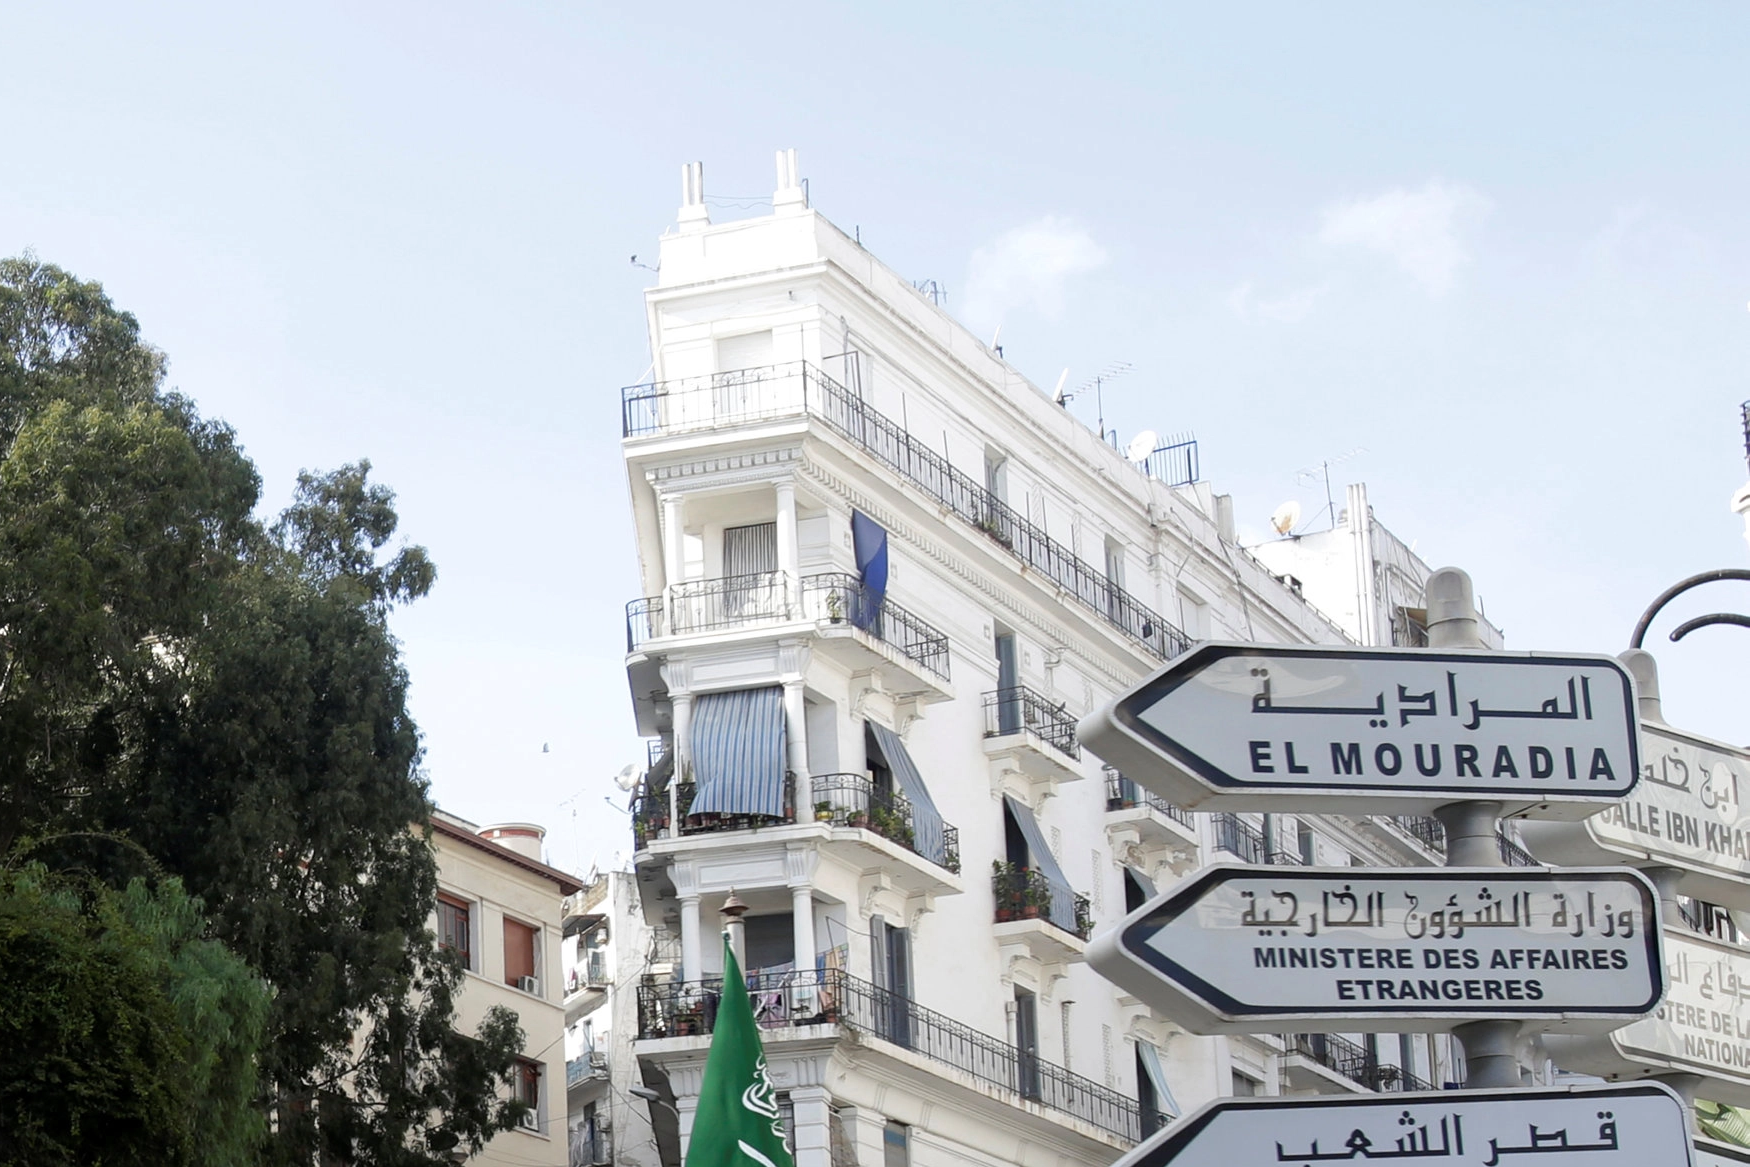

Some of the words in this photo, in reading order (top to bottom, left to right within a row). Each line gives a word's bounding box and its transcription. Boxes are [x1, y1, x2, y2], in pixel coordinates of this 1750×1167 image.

[1250, 668, 1593, 730] المرادية
[1249, 741, 1309, 774] EL
[1330, 742, 1616, 781] MOURADIA
[1665, 810, 1700, 848] IBN
[1240, 884, 1384, 938] الخارجية
[1404, 887, 1531, 939] الشؤون
[1551, 890, 1635, 939] وزارة
[1253, 947, 1413, 970] MINISTERE
[1424, 948, 1480, 969] DES
[1490, 949, 1629, 970] AFFAIRES
[1336, 979, 1544, 1001] ETRANGERES
[1711, 1011, 1733, 1036] DE
[1482, 1110, 1619, 1167] قصر
